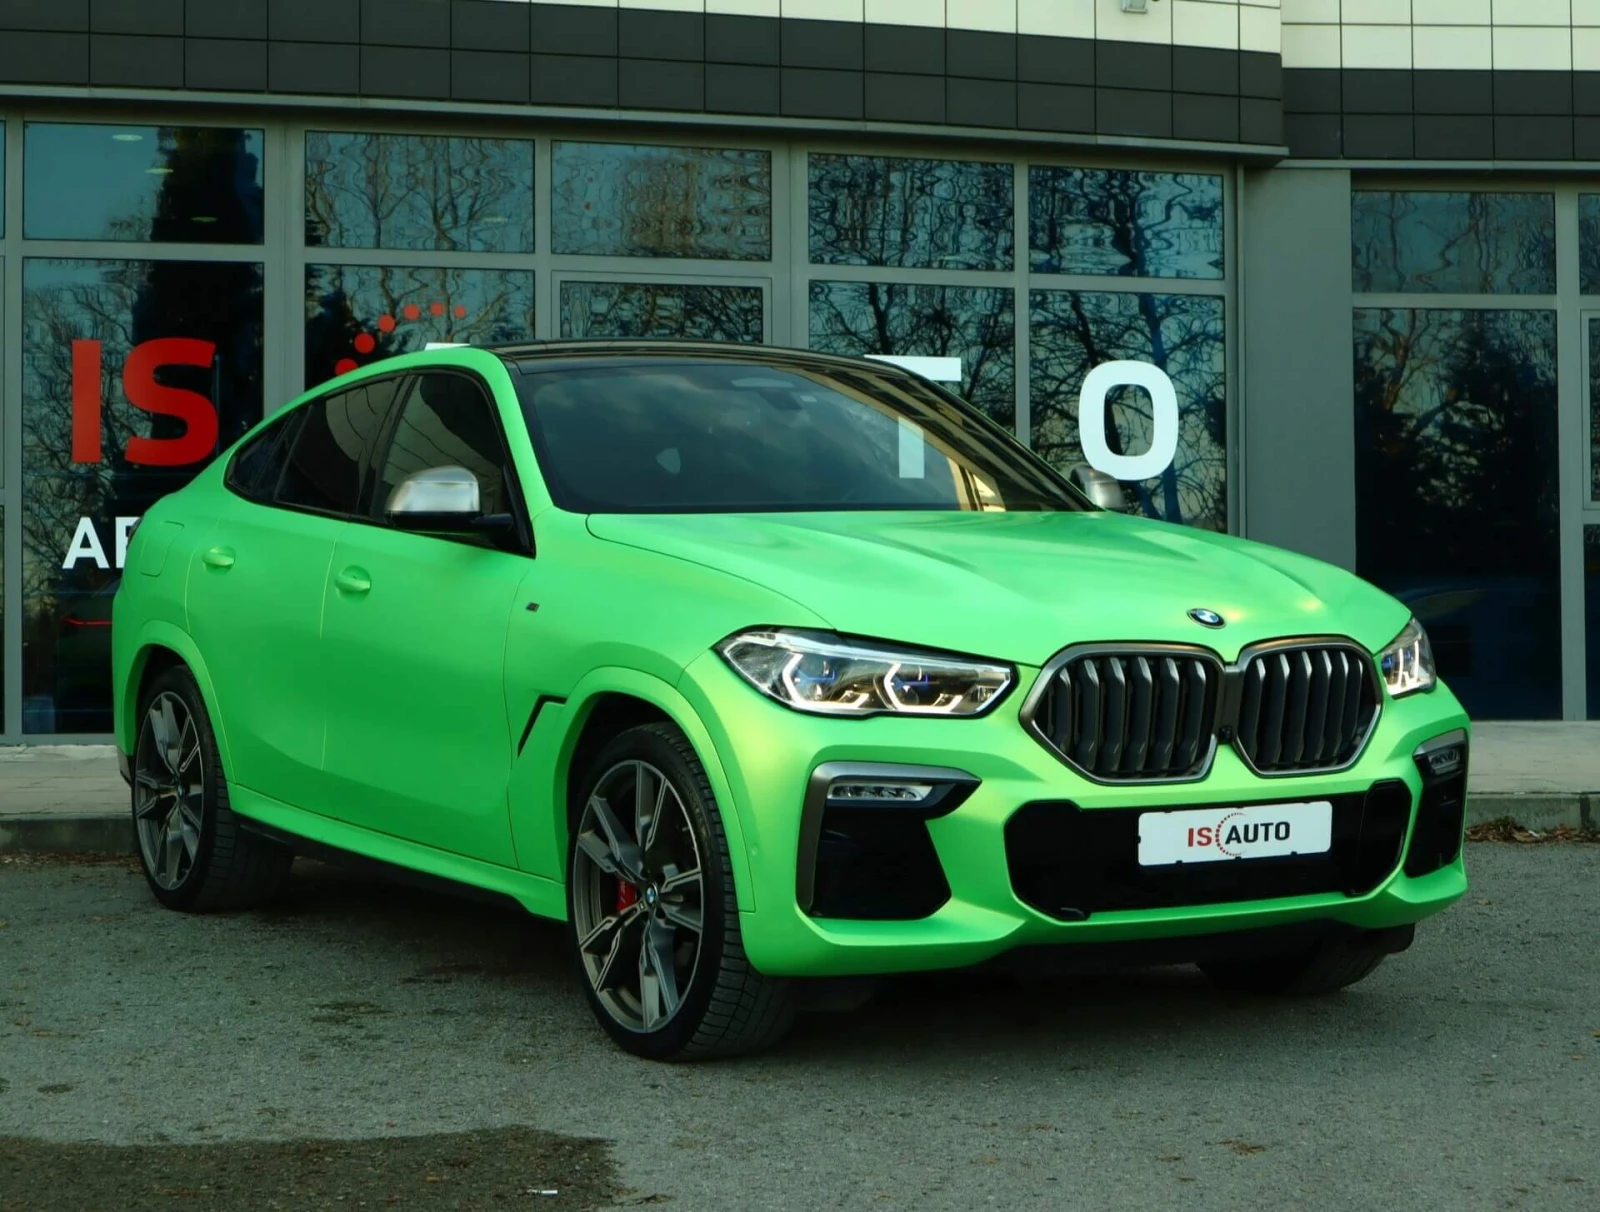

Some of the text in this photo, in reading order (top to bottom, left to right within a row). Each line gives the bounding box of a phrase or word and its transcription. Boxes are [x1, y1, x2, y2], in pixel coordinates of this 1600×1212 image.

[71, 337, 219, 466] IS
[1187, 821, 1291, 847] IS AUTO
